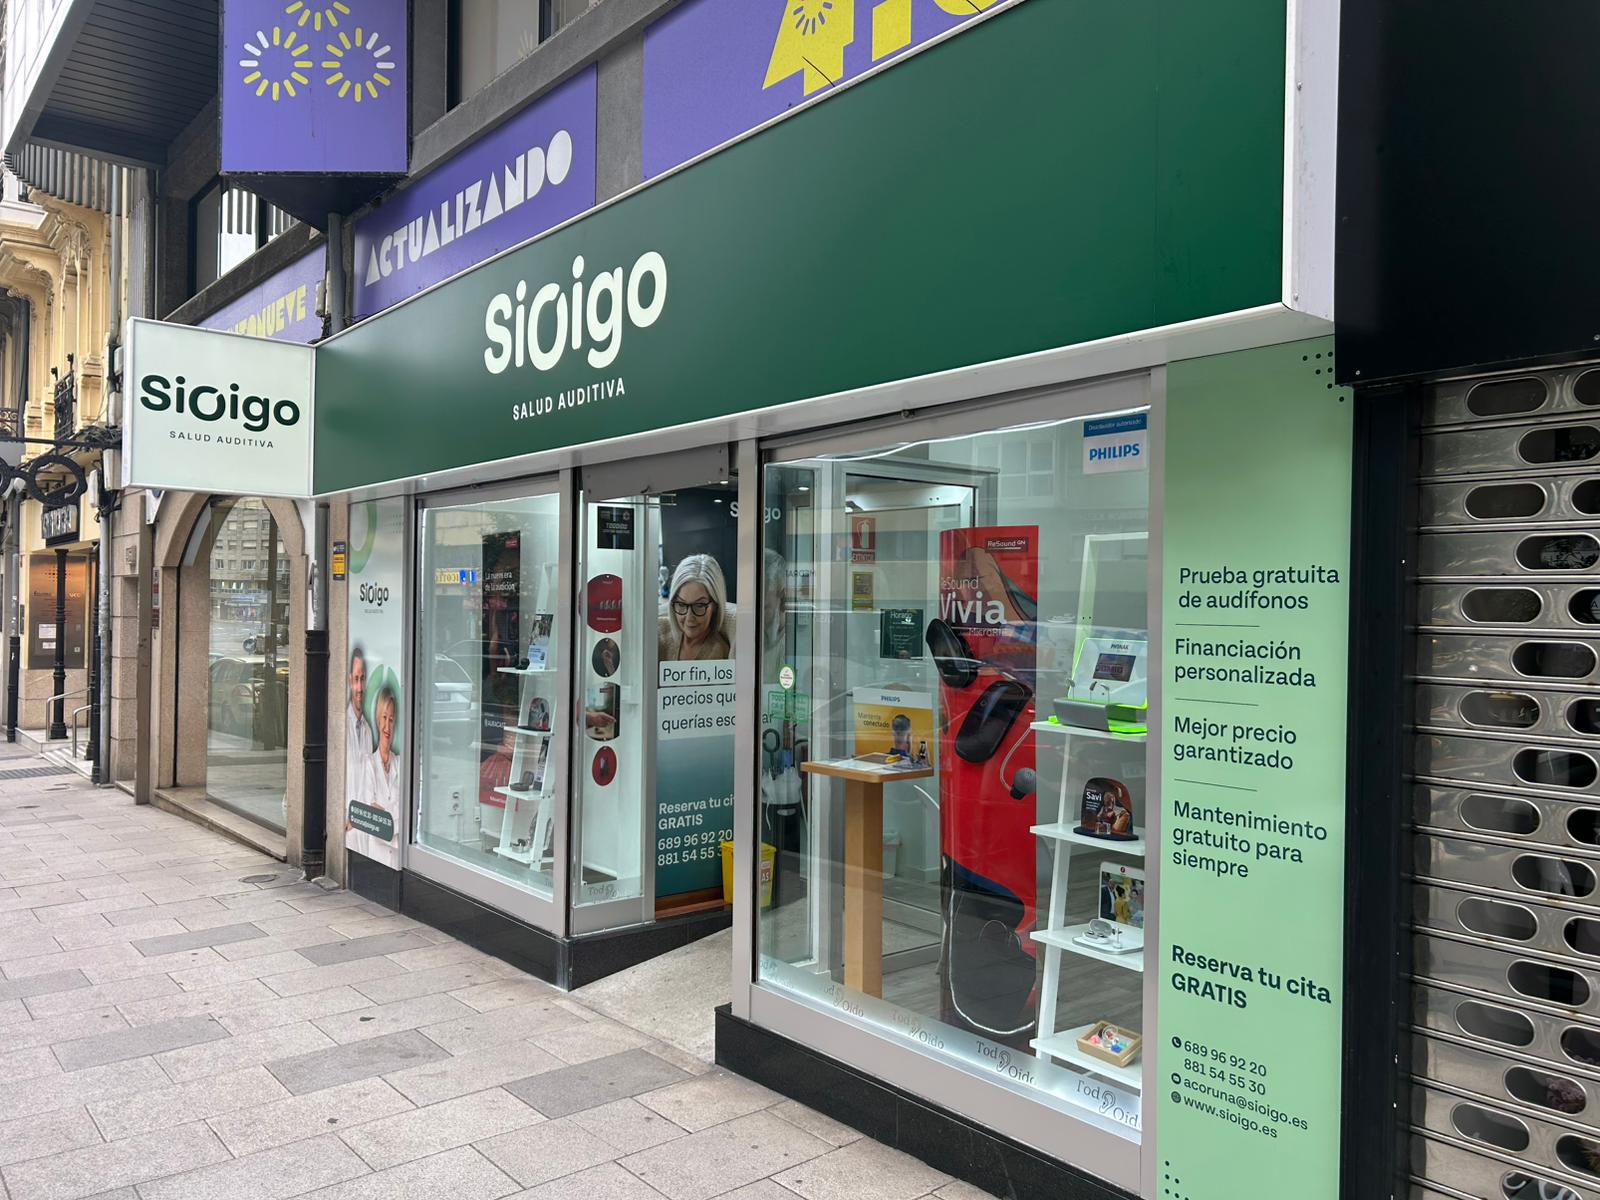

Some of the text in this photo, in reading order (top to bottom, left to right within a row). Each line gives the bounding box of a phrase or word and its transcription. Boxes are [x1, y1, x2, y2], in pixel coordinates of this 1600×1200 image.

[365, 129, 573, 287] ACTUALIZANDO
[513, 377, 626, 421] SALUD AUDITIVA
[169, 430, 274, 449] SALUD AUDITIVA
[1089, 443, 1140, 461] PHILIPS
[1179, 565, 1340, 588] Prueba gratuita
[940, 590, 1007, 625] Vivia
[1178, 590, 1309, 609] de audífonos
[1175, 638, 1301, 660] Financiación
[663, 666, 733, 682] Por fin, los
[1174, 665, 1316, 687] personalizada
[662, 691, 713, 710] precios
[661, 714, 713, 734] querías
[1174, 715, 1297, 745] Mejor precio
[1173, 743, 1293, 770] garantizado
[659, 800, 706, 815] Reserva
[709, 797, 721, 809] tu
[658, 814, 703, 830] GRATIS
[1173, 800, 1328, 841] Mantenimiento
[658, 829, 733, 851] 689 96 92 20
[1173, 827, 1303, 863] gratuito para
[657, 851, 679, 866] 881
[682, 849, 697, 863] 54
[700, 846, 715, 860] 55
[1172, 849, 1249, 878] siempre
[1172, 944, 1332, 1004] Reserva tu cita
[1171, 973, 1247, 1009] GRATIS
[976, 1040, 998, 1059] Tod
[1184, 1040, 1267, 1077] 689 96 92 20
[1183, 1058, 1266, 1095] 881 54 55 30
[1076, 1079, 1100, 1100] Tod
[1183, 1077, 1308, 1130] acoruna@sioigo.es
[1112, 1106, 1141, 1128] Oid
[1183, 1095, 1278, 1138] www.sioigo.es
